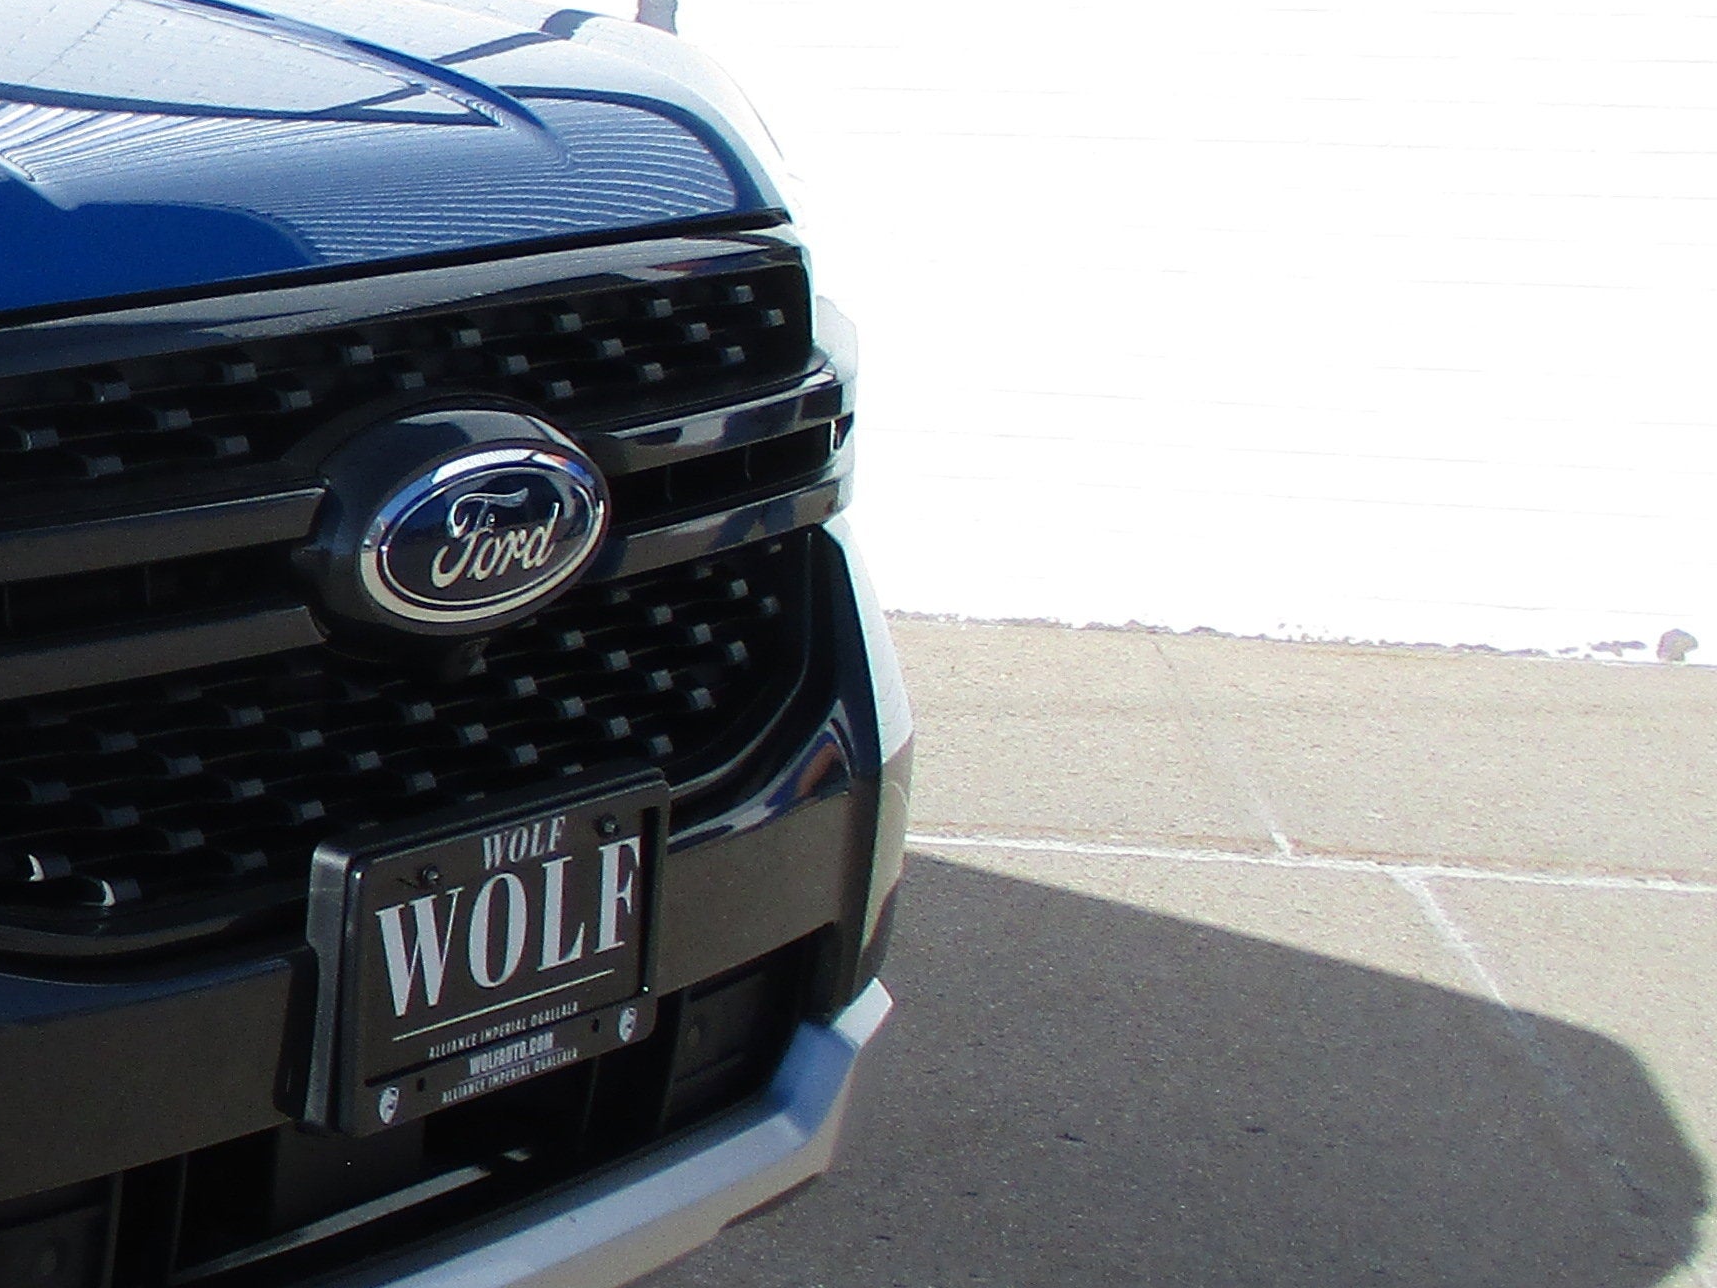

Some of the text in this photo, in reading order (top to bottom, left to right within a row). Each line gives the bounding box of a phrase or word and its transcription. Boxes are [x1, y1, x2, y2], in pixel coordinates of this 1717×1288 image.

[430, 487, 560, 588] Ford
[482, 816, 566, 870] WOLF
[375, 836, 641, 1017] WOLF
[428, 1033, 477, 1058] ALLIANCE
[480, 1018, 526, 1043] IMPERIAL
